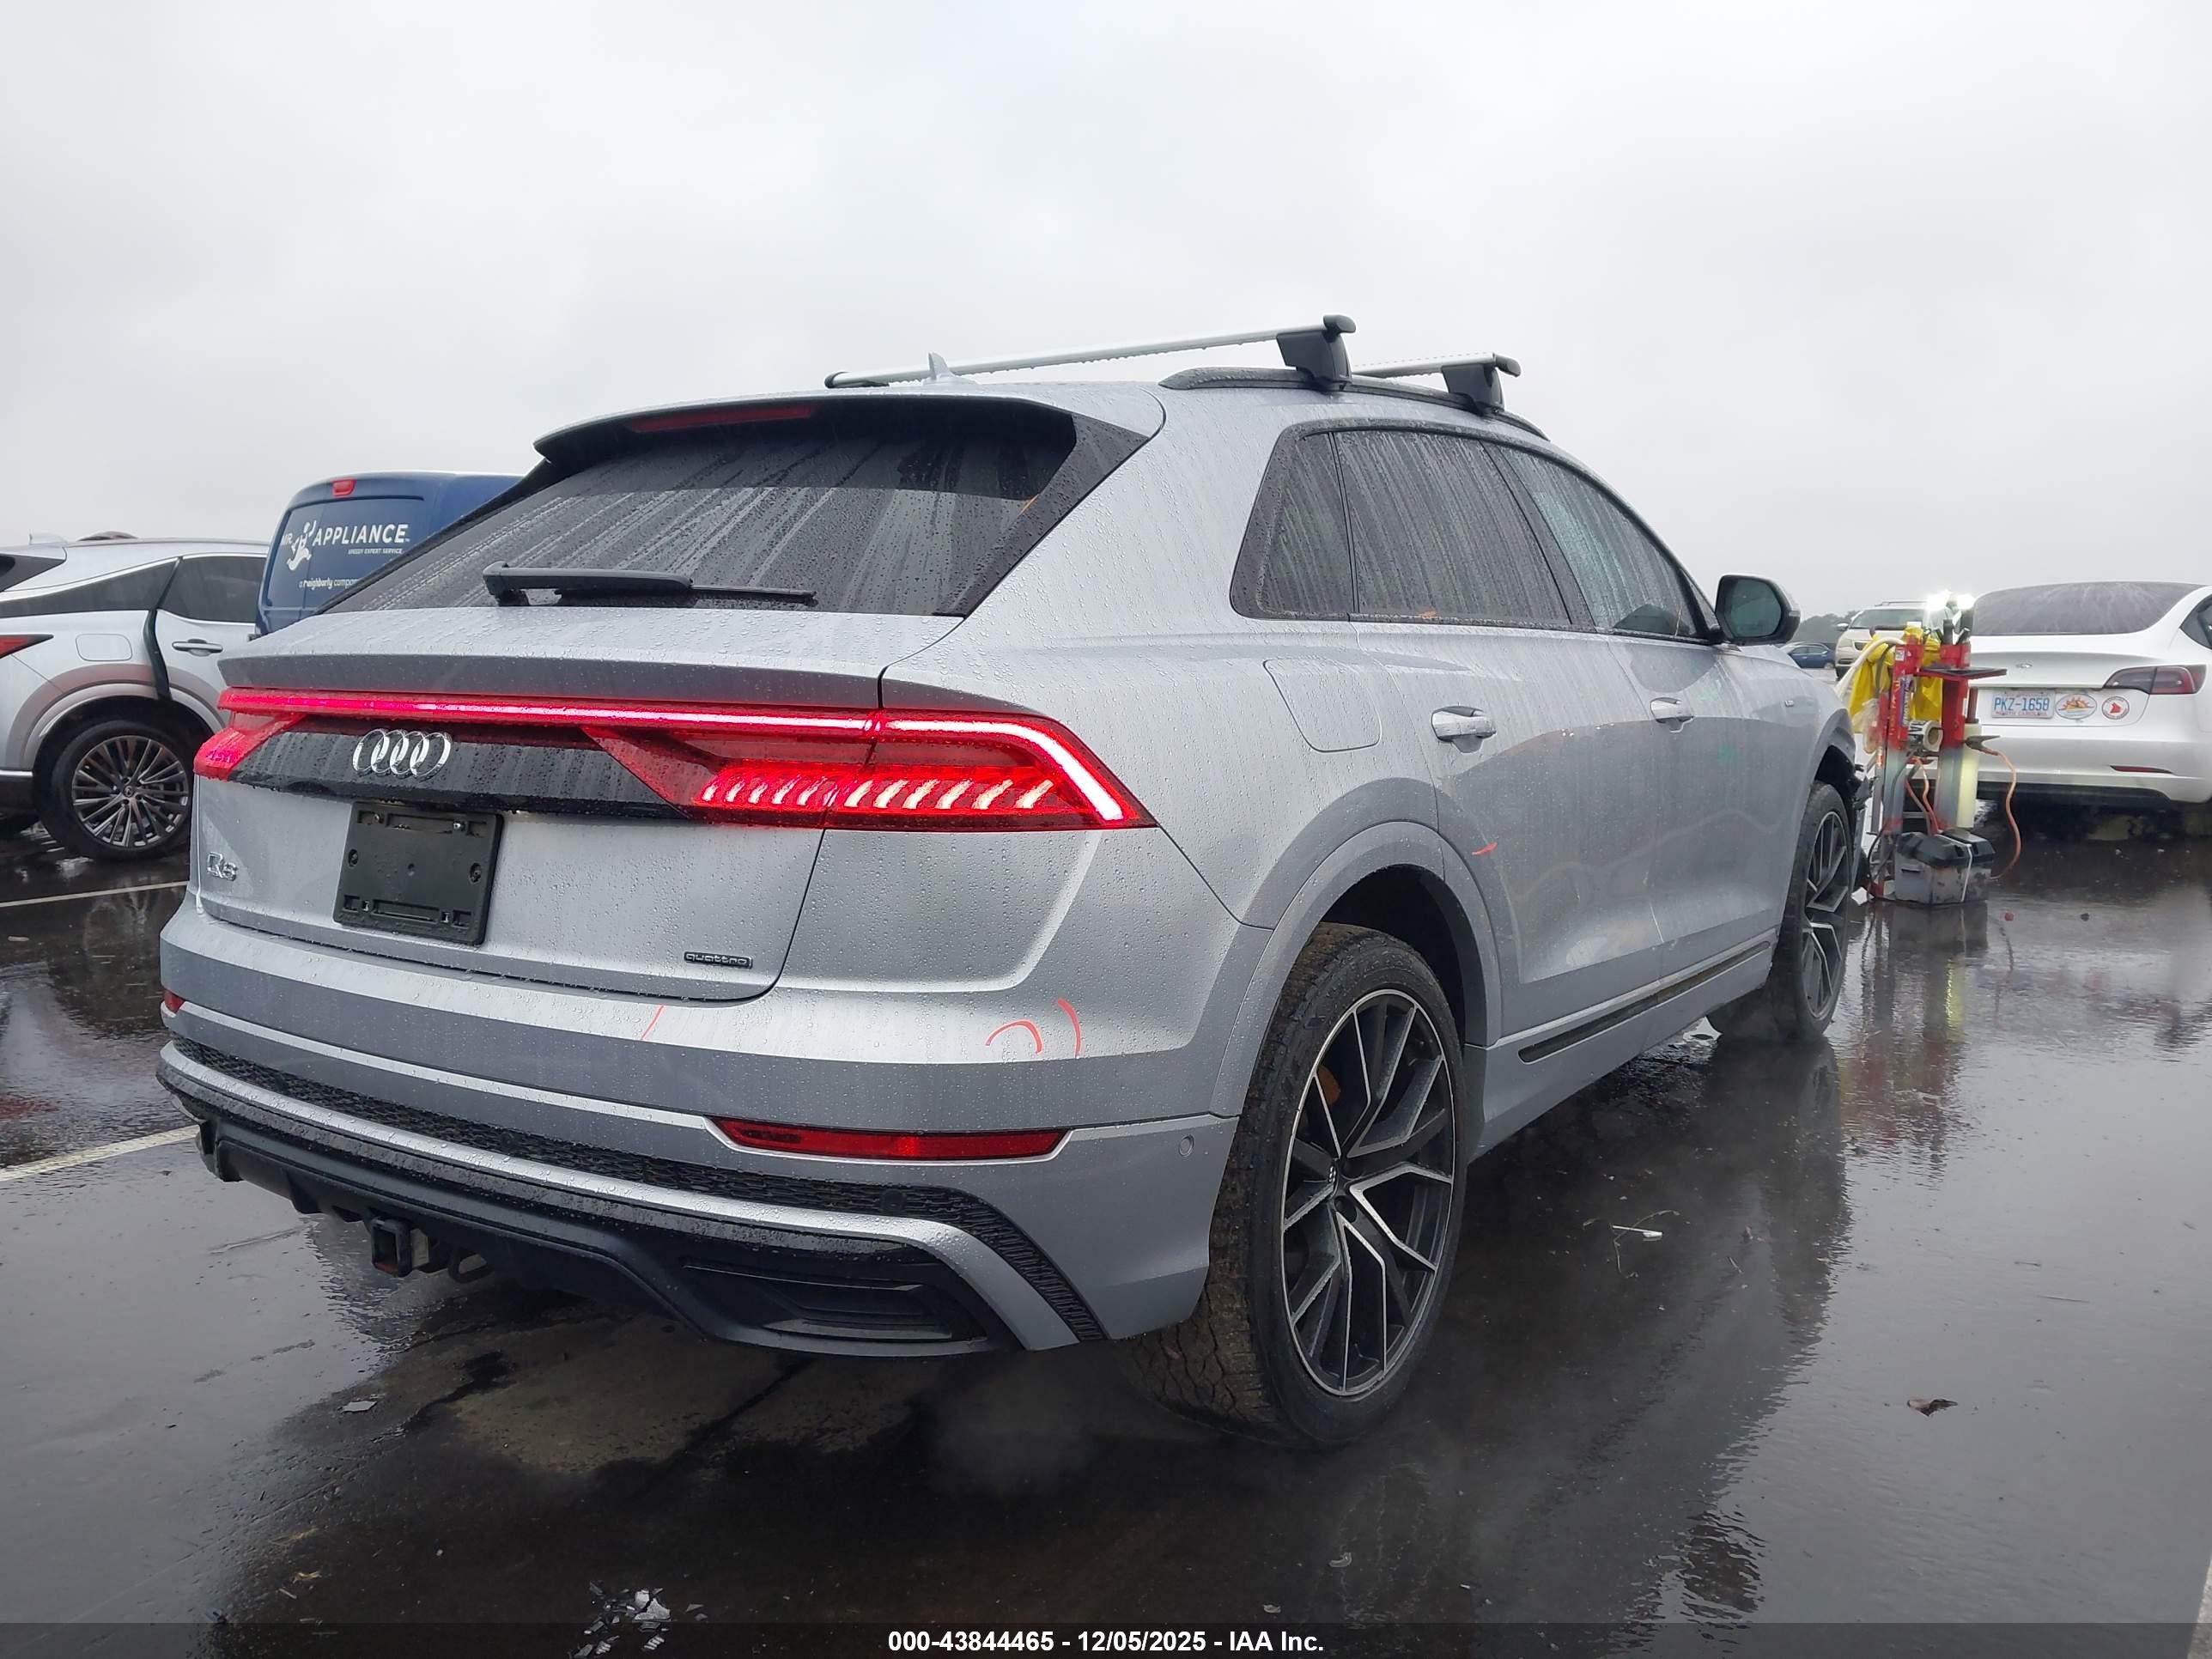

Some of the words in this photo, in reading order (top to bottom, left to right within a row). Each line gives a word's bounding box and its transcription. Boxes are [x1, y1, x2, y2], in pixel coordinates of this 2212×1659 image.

[312, 524, 408, 547] APPLIANCE
[1994, 696, 2051, 711] PKZ-1658
[686, 953, 747, 964] quattro
